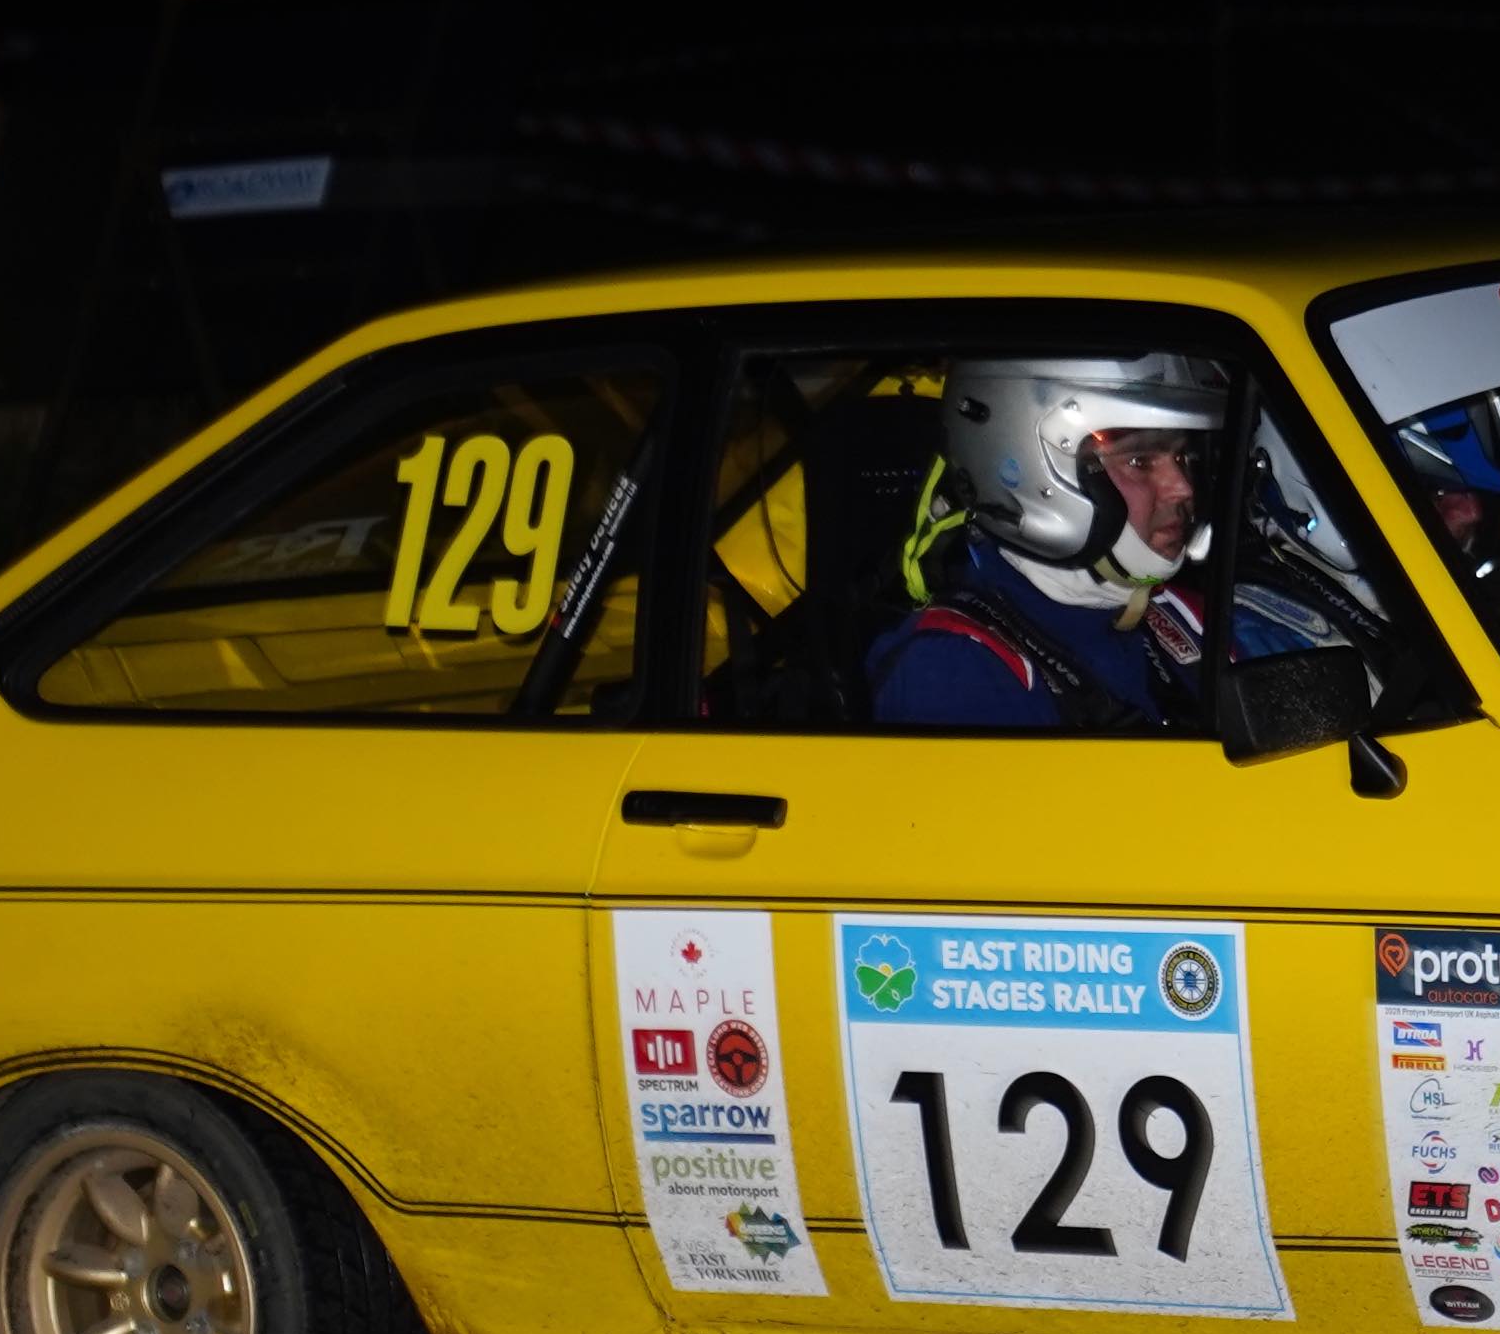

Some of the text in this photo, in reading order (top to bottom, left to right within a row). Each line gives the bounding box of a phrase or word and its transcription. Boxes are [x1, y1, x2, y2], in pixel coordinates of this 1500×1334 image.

[383, 432, 575, 635] 129
[940, 940, 1133, 976] EAST RIDING
[634, 988, 756, 1015] MAPLE
[932, 979, 1050, 1012] STAGES
[1054, 982, 1146, 1015] RALLY
[1427, 988, 1499, 1004] autocare
[1392, 1055, 1445, 1071] PIRELLI
[637, 1079, 699, 1093] SPECTRUM
[1423, 1091, 1451, 1106] HSL
[641, 1101, 771, 1132] sparrow
[1411, 1145, 1457, 1159] FUCHS
[650, 1148, 777, 1185] positive
[889, 1070, 1214, 1264] 129
[668, 1182, 780, 1199] about motorsport
[1411, 1183, 1470, 1208] ETS
[688, 1253, 727, 1266] EAST
[1411, 1254, 1490, 1271] LEGEND
[695, 1267, 785, 1283] YORKSHIRE
